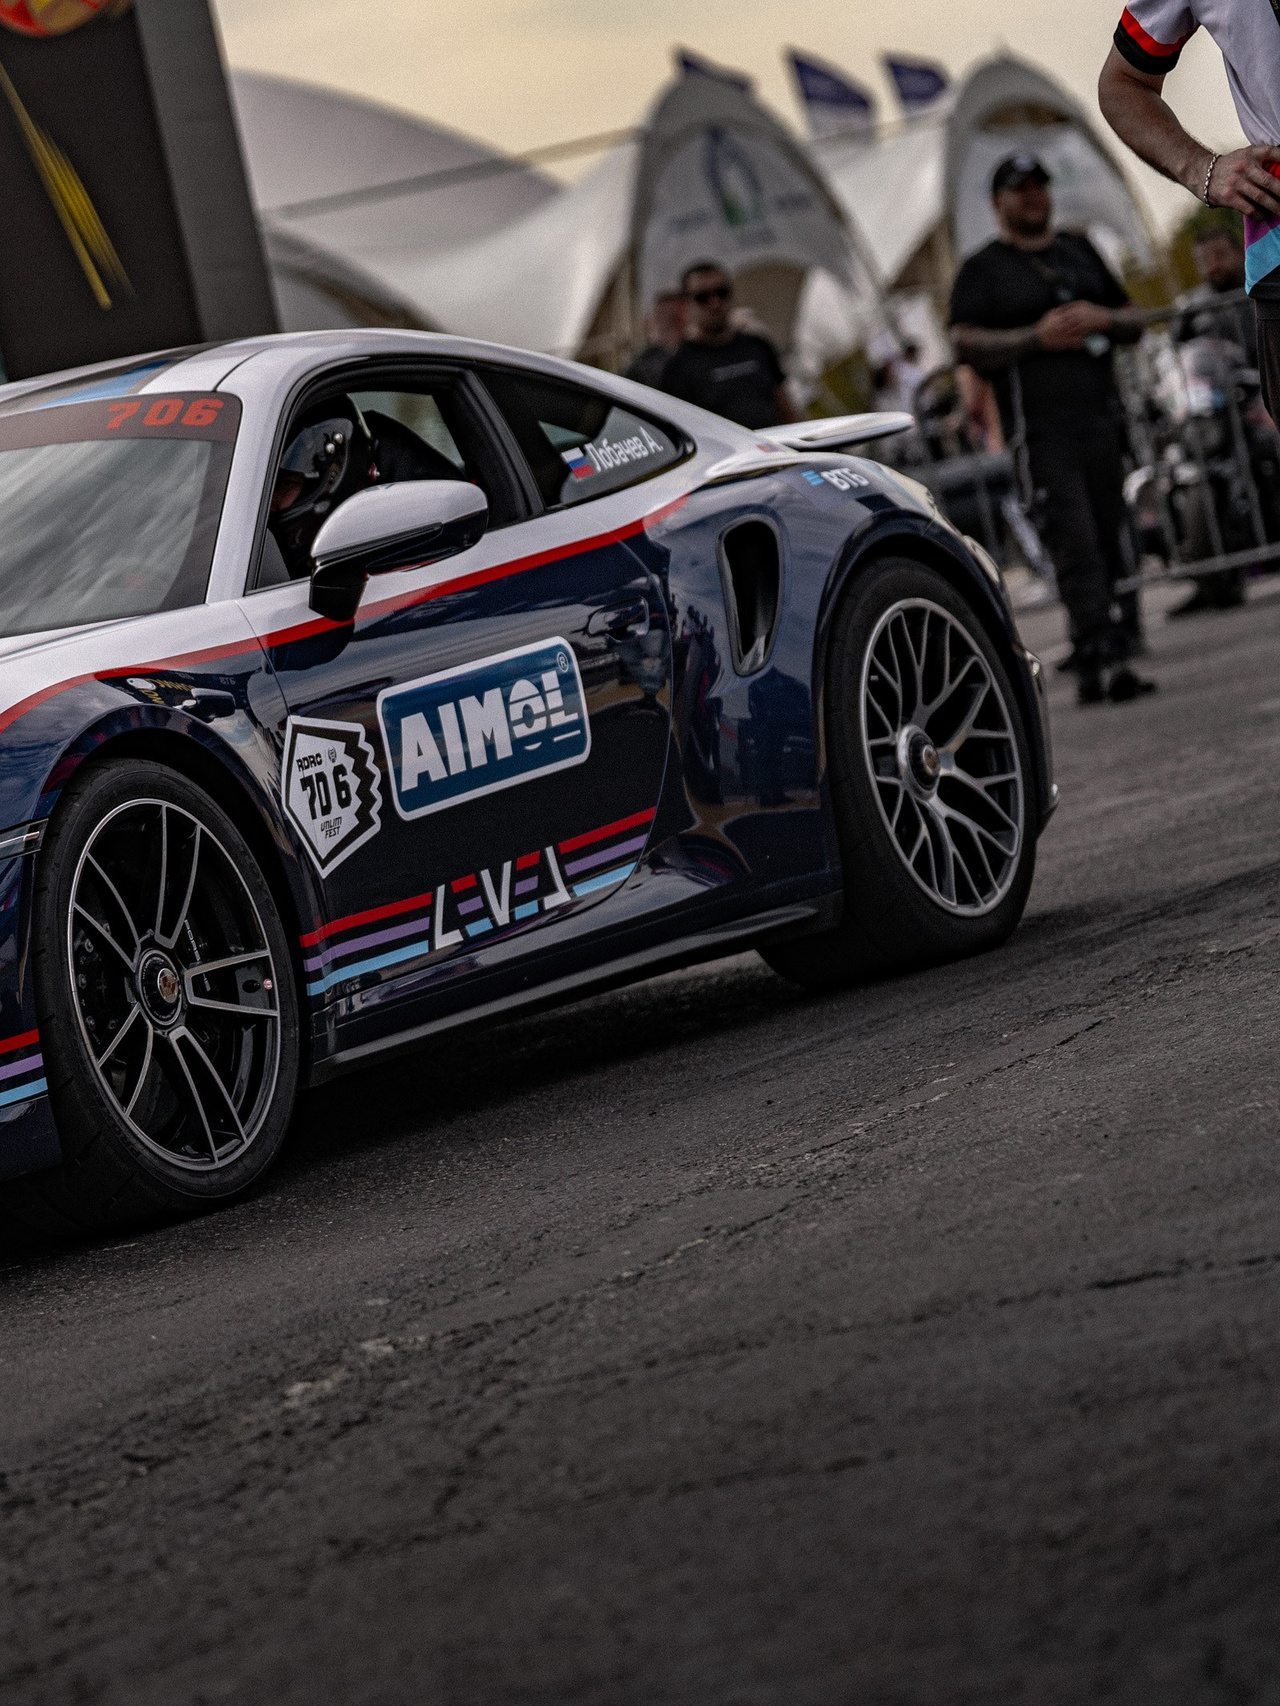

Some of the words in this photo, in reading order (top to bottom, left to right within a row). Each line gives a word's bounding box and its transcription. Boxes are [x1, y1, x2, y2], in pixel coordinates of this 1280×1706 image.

[106, 398, 224, 430] 706
[401, 669, 579, 792] AIMOL
[299, 763, 353, 820] 706
[324, 826, 341, 839] FEST
